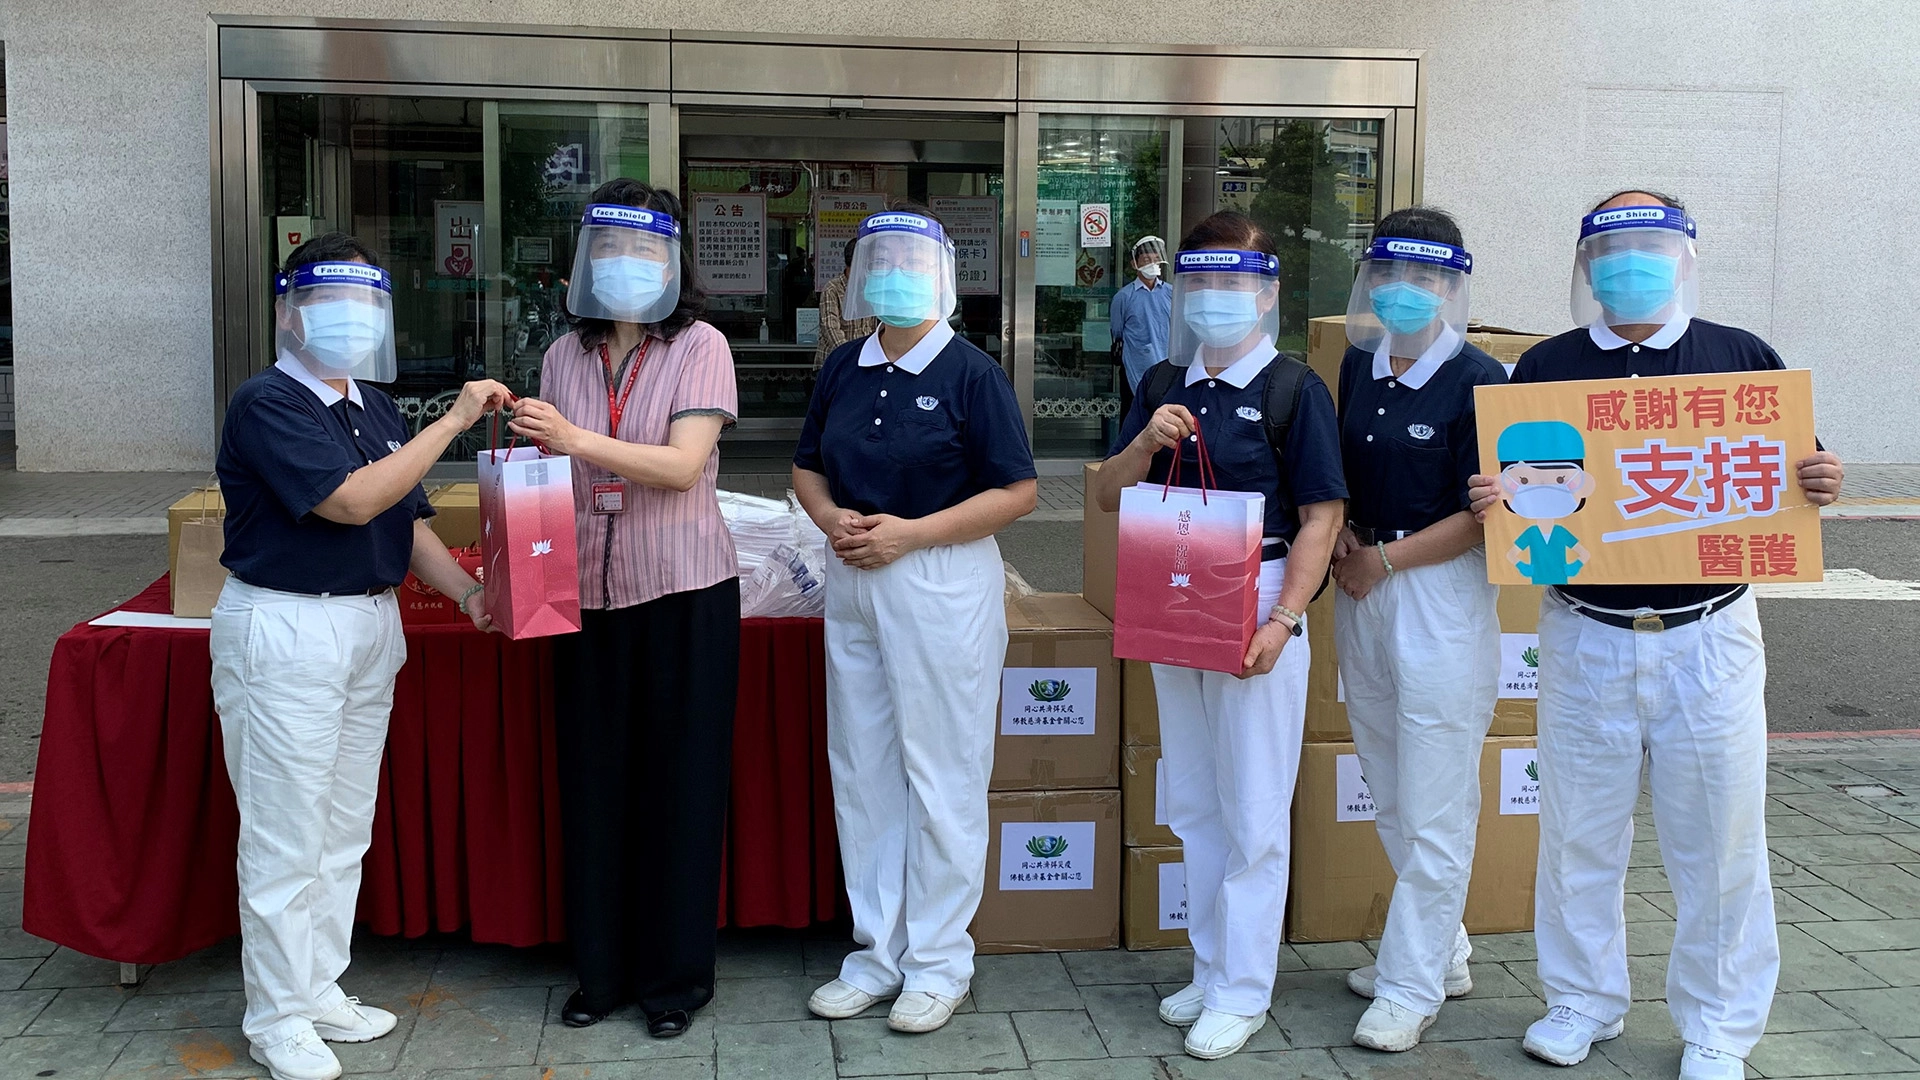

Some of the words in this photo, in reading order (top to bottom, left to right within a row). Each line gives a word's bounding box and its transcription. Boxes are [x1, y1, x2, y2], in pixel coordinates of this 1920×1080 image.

[714, 204, 744, 217] 公告
[834, 201, 868, 210] 防疫公告
[618, 211, 646, 220] Shield
[871, 217, 890, 225] Face
[894, 216, 922, 226] Shield
[1599, 214, 1622, 222] Face
[1393, 243, 1416, 252] Face
[1420, 246, 1448, 256] Shield
[320, 266, 344, 274] Face
[348, 268, 377, 278] Shield
[1586, 384, 1781, 432] 感謝有您
[1619, 439, 1783, 516] 支持
[1697, 533, 1798, 577] 醫護
